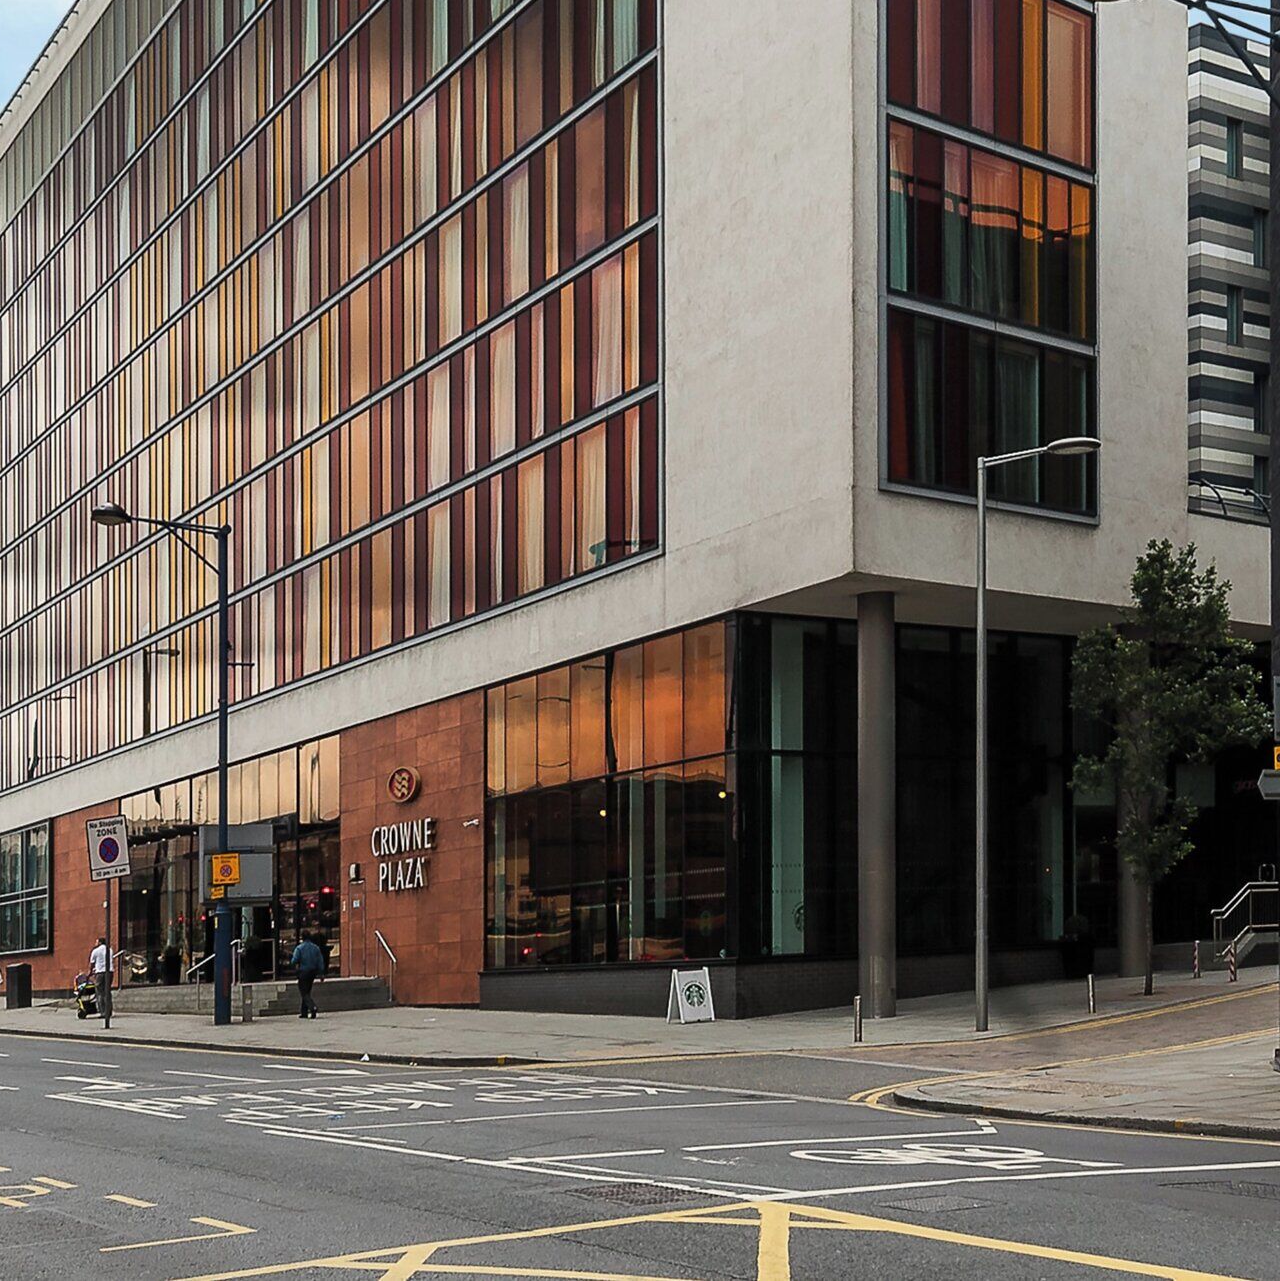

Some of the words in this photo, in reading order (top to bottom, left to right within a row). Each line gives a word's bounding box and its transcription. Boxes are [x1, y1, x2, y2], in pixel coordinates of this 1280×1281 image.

[96, 826, 118, 837] ZONE
[371, 817, 432, 857] CROWNE
[379, 856, 424, 892] PLAZA
